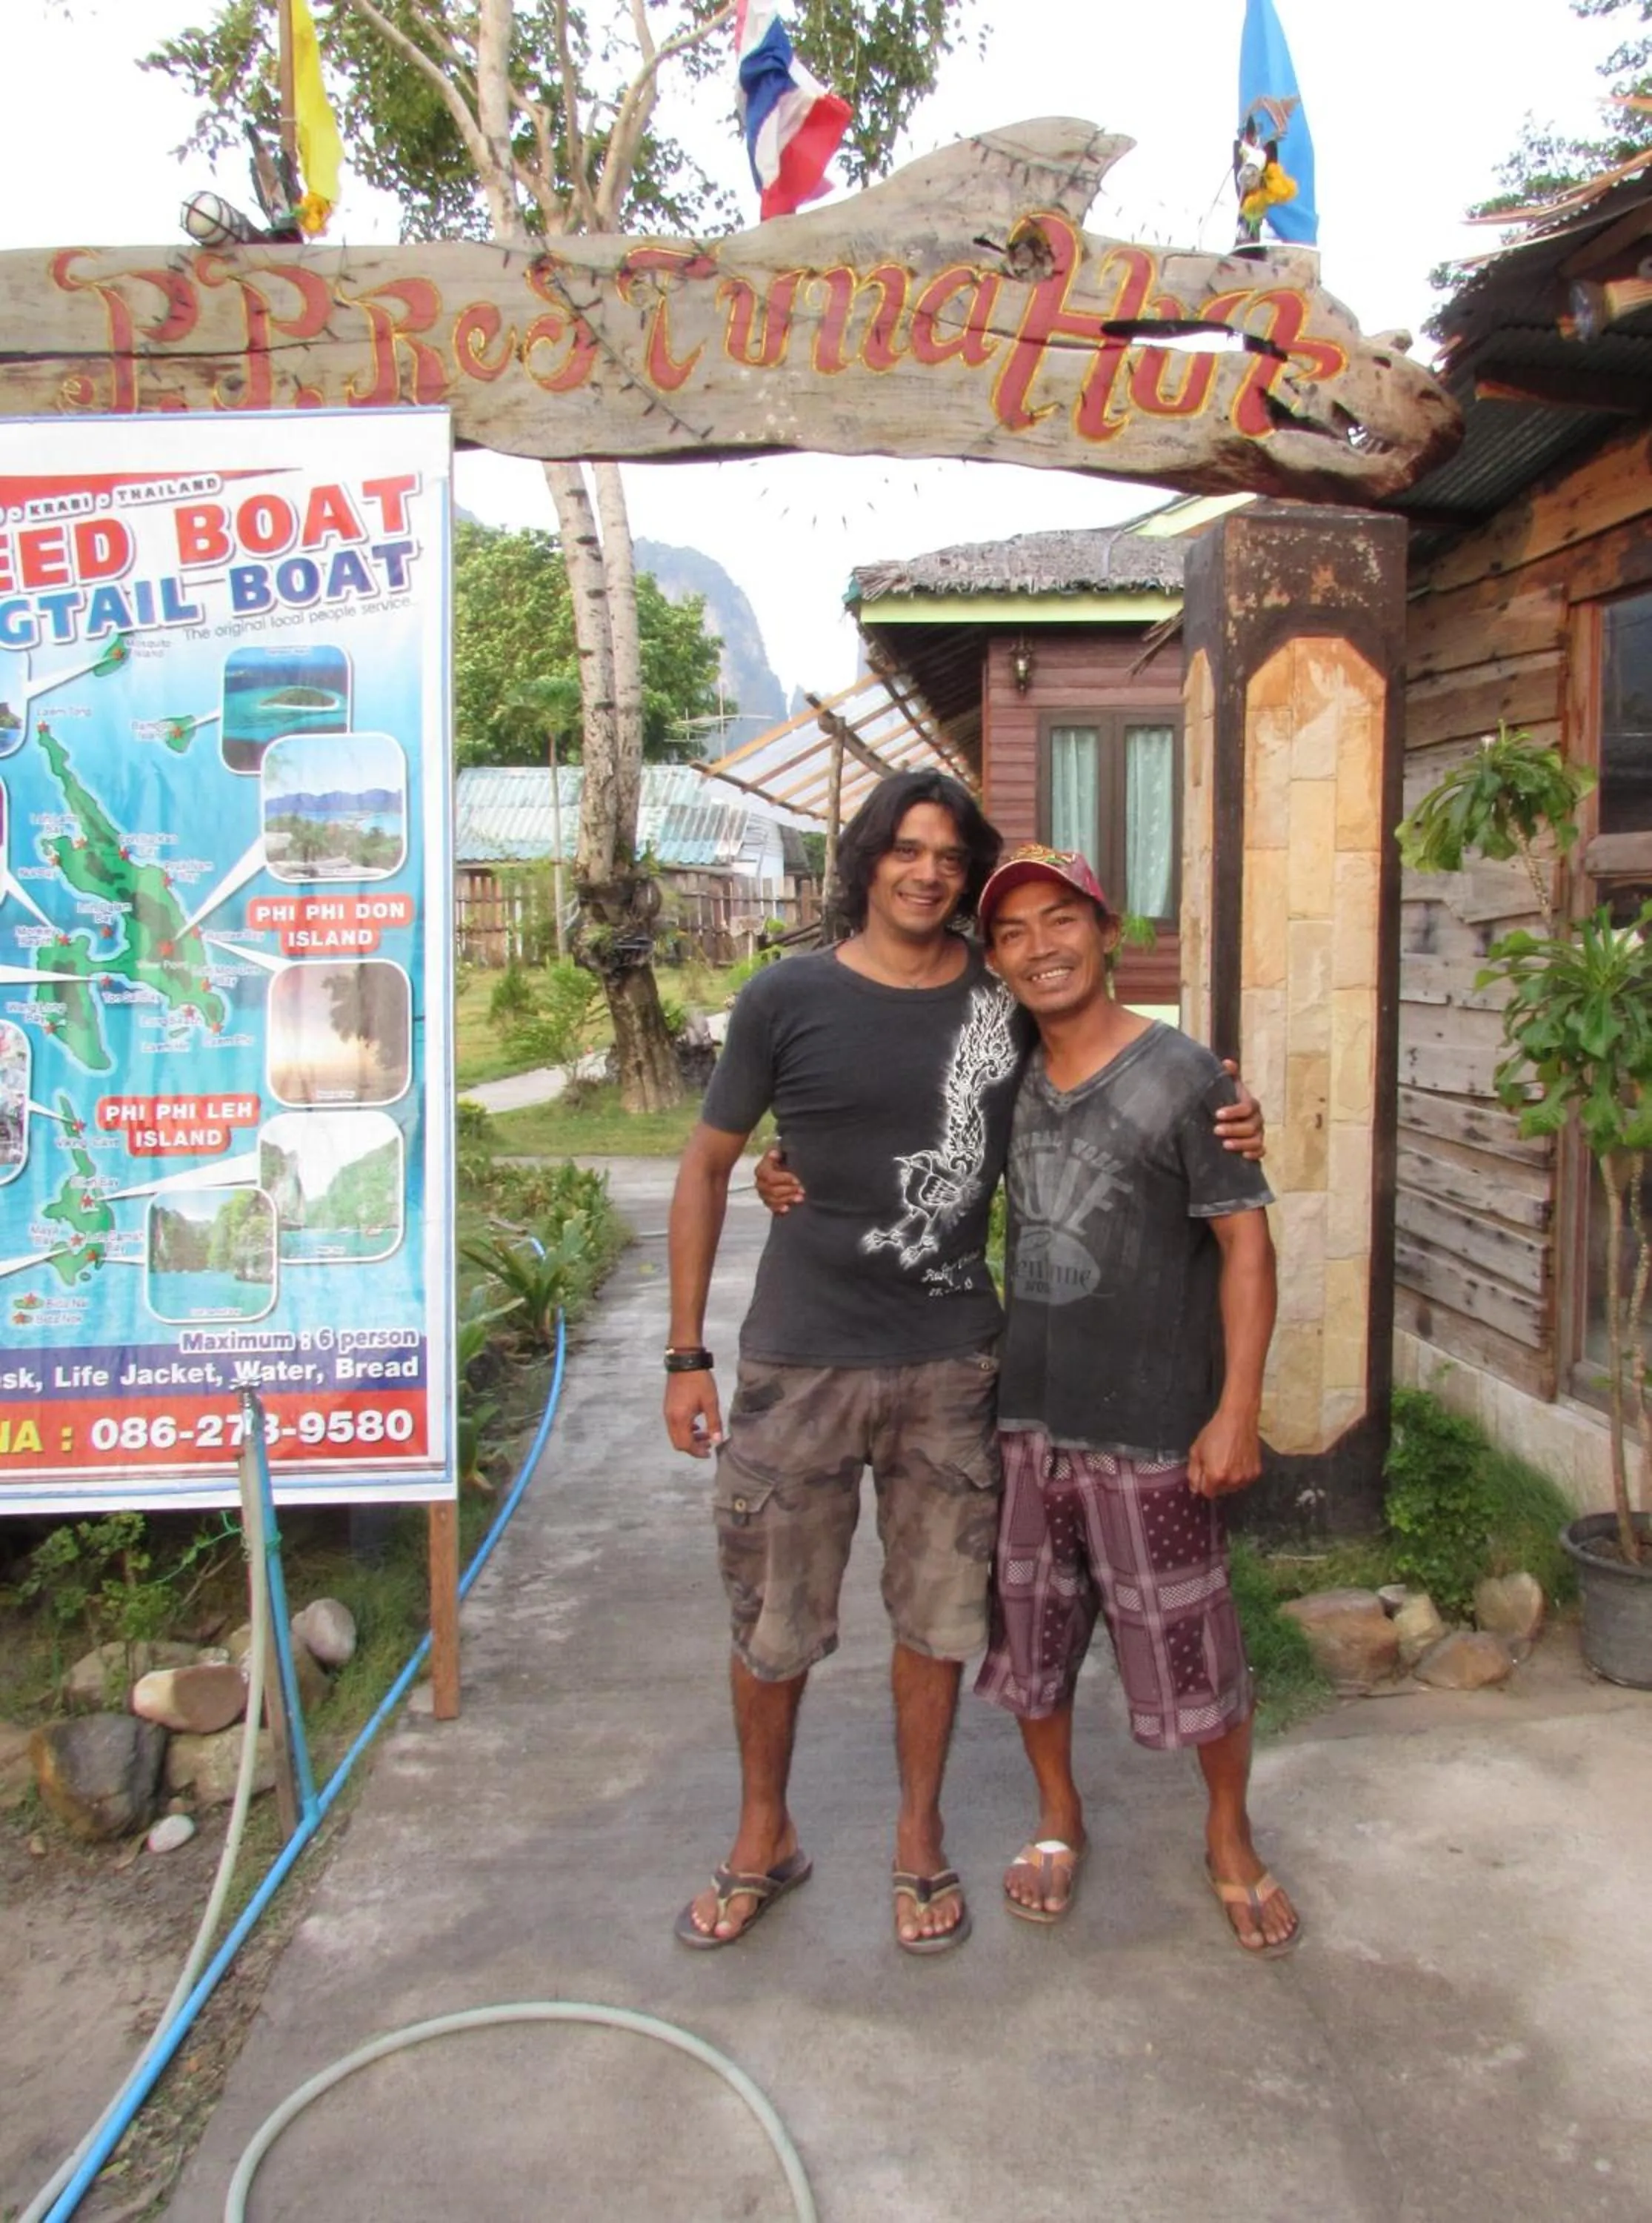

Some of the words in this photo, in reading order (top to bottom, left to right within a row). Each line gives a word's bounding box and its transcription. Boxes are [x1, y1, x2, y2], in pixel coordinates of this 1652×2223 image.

[28, 496, 90, 516] KRABI
[116, 476, 219, 502] THAILAND
[0, 518, 130, 591] ED
[174, 475, 416, 565] BOAT
[229, 541, 413, 613] BOAT
[184, 626, 210, 641] The
[214, 619, 266, 638] original
[270, 612, 304, 629] local
[309, 604, 357, 625] people
[256, 906, 295, 922] PHI
[305, 904, 344, 920] PHI
[356, 903, 404, 919] DON
[288, 929, 373, 947] ISLAND
[106, 1104, 145, 1121] PHI
[156, 1103, 196, 1120] PHI
[207, 1102, 252, 1118] LEH
[136, 1130, 222, 1147] ISLAND
[182, 1332, 294, 1352] Maximum
[317, 1329, 332, 1349] 6
[340, 1329, 417, 1352] person
[0, 1368, 42, 1392] sk,
[55, 1365, 109, 1387] Life
[119, 1361, 223, 1386] Jacket,
[233, 1360, 324, 1383] Water,
[336, 1357, 419, 1379] Bread
